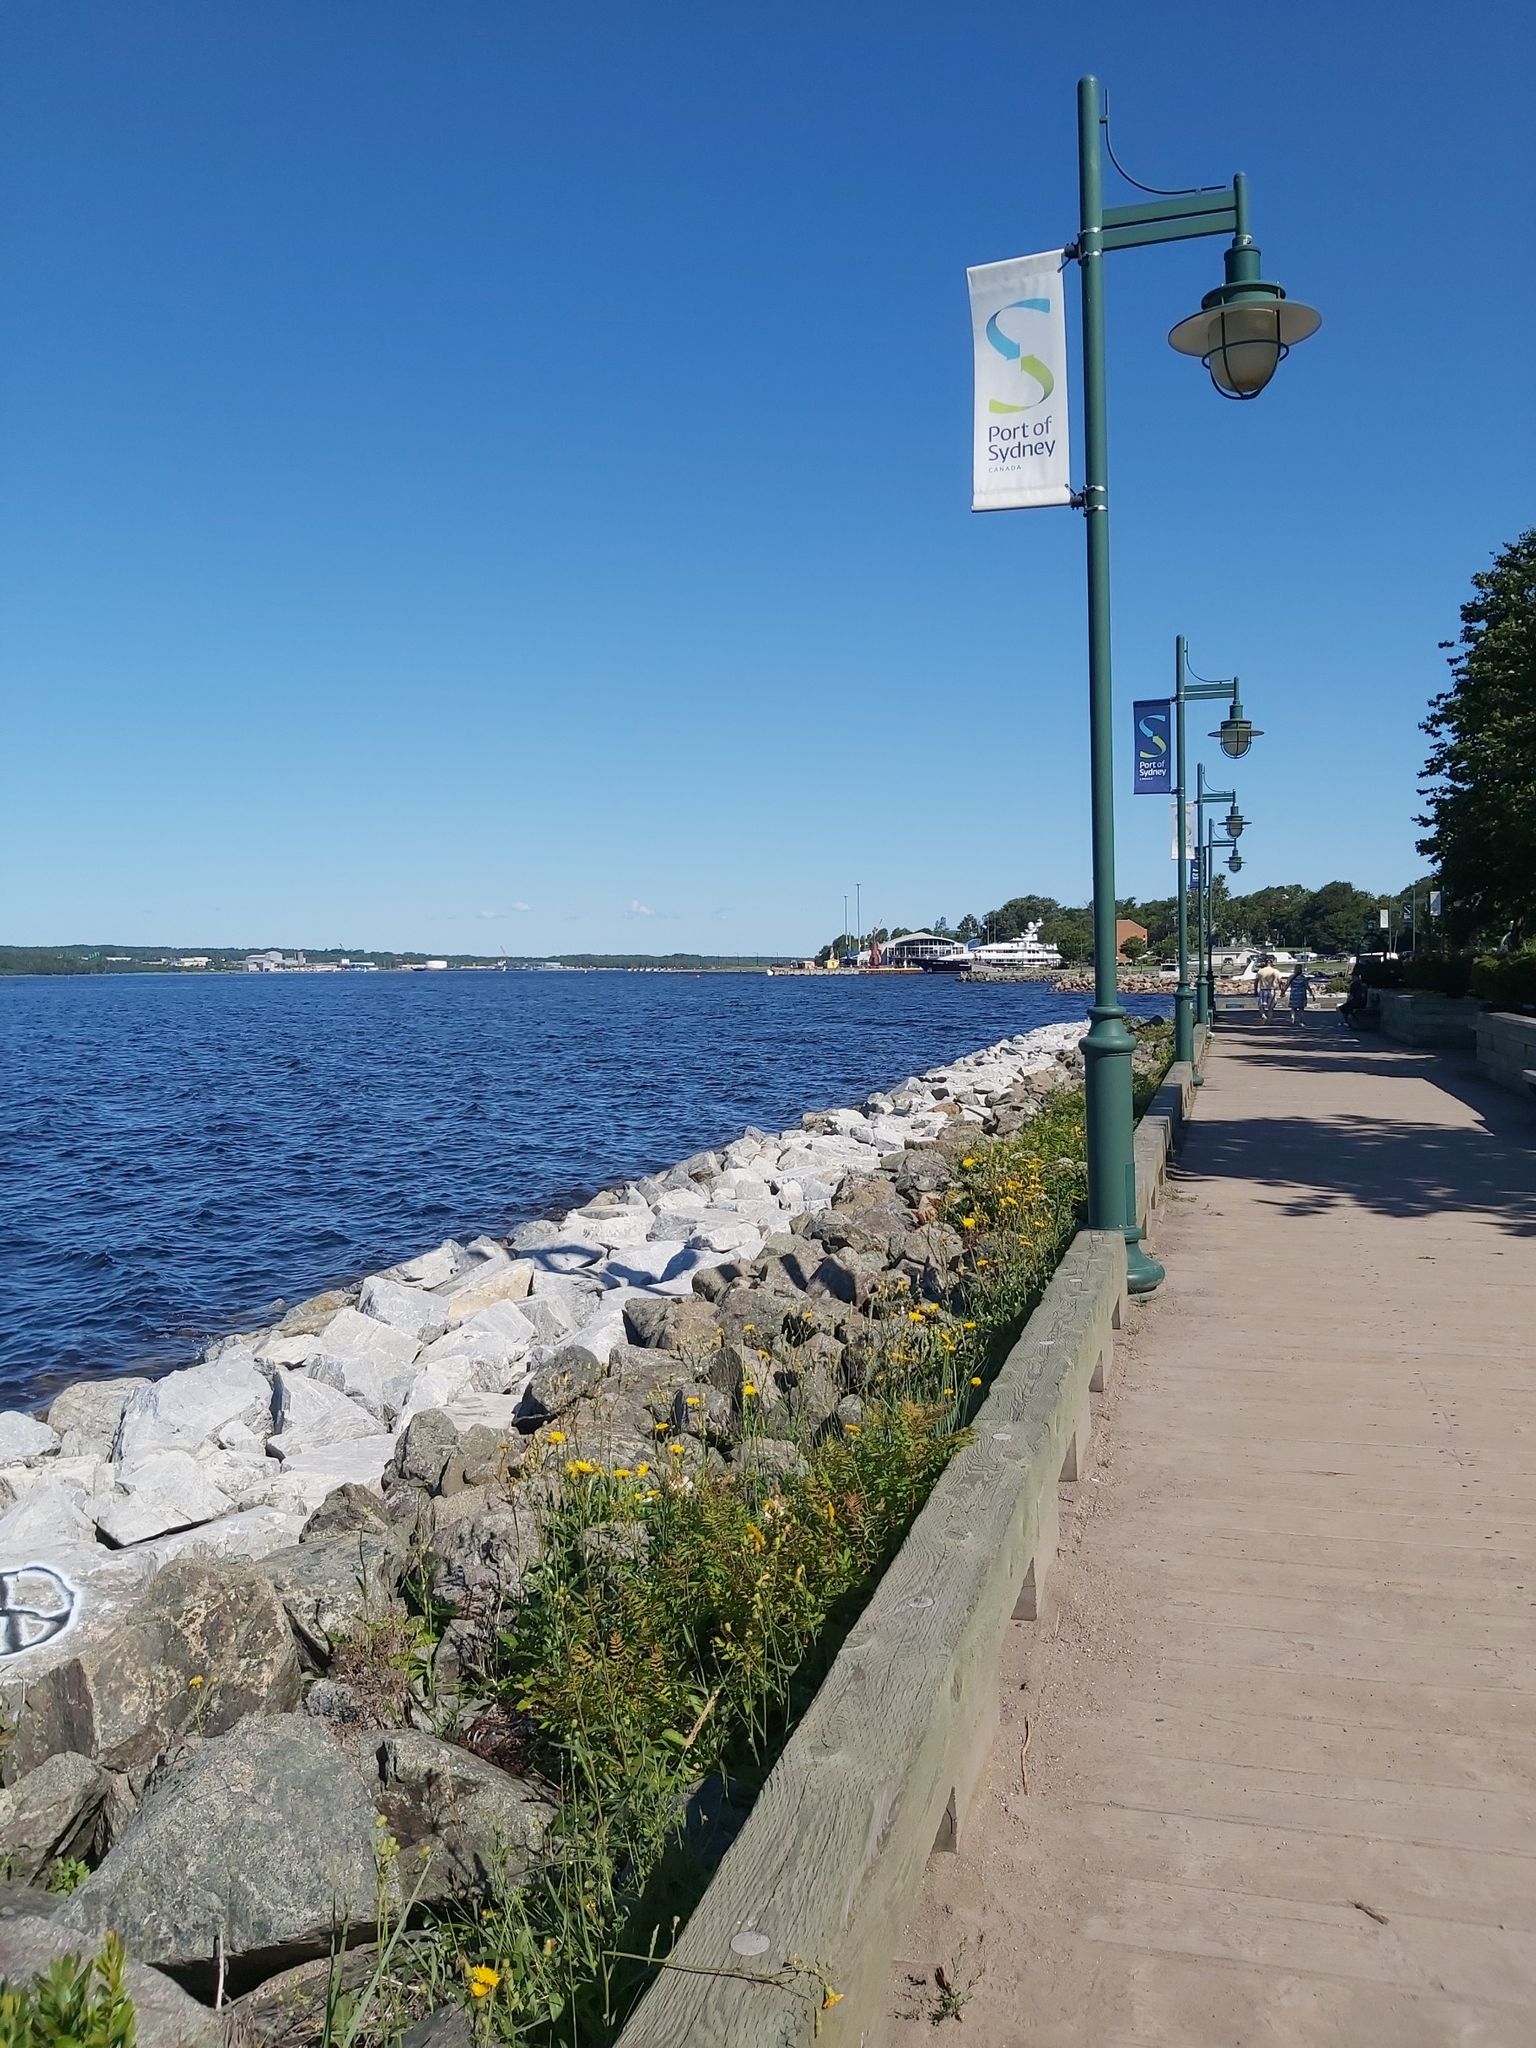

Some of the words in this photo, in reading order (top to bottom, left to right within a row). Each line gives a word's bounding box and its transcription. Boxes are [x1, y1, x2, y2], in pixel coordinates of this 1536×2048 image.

[989, 422, 1029, 443] Port
[1033, 415, 1052, 436] of
[988, 439, 1056, 463] Sydney
[988, 465, 1022, 473] CANADA
[1139, 761, 1157, 769] Port
[1157, 760, 1165, 768] of
[1139, 768, 1167, 777] Sydney
